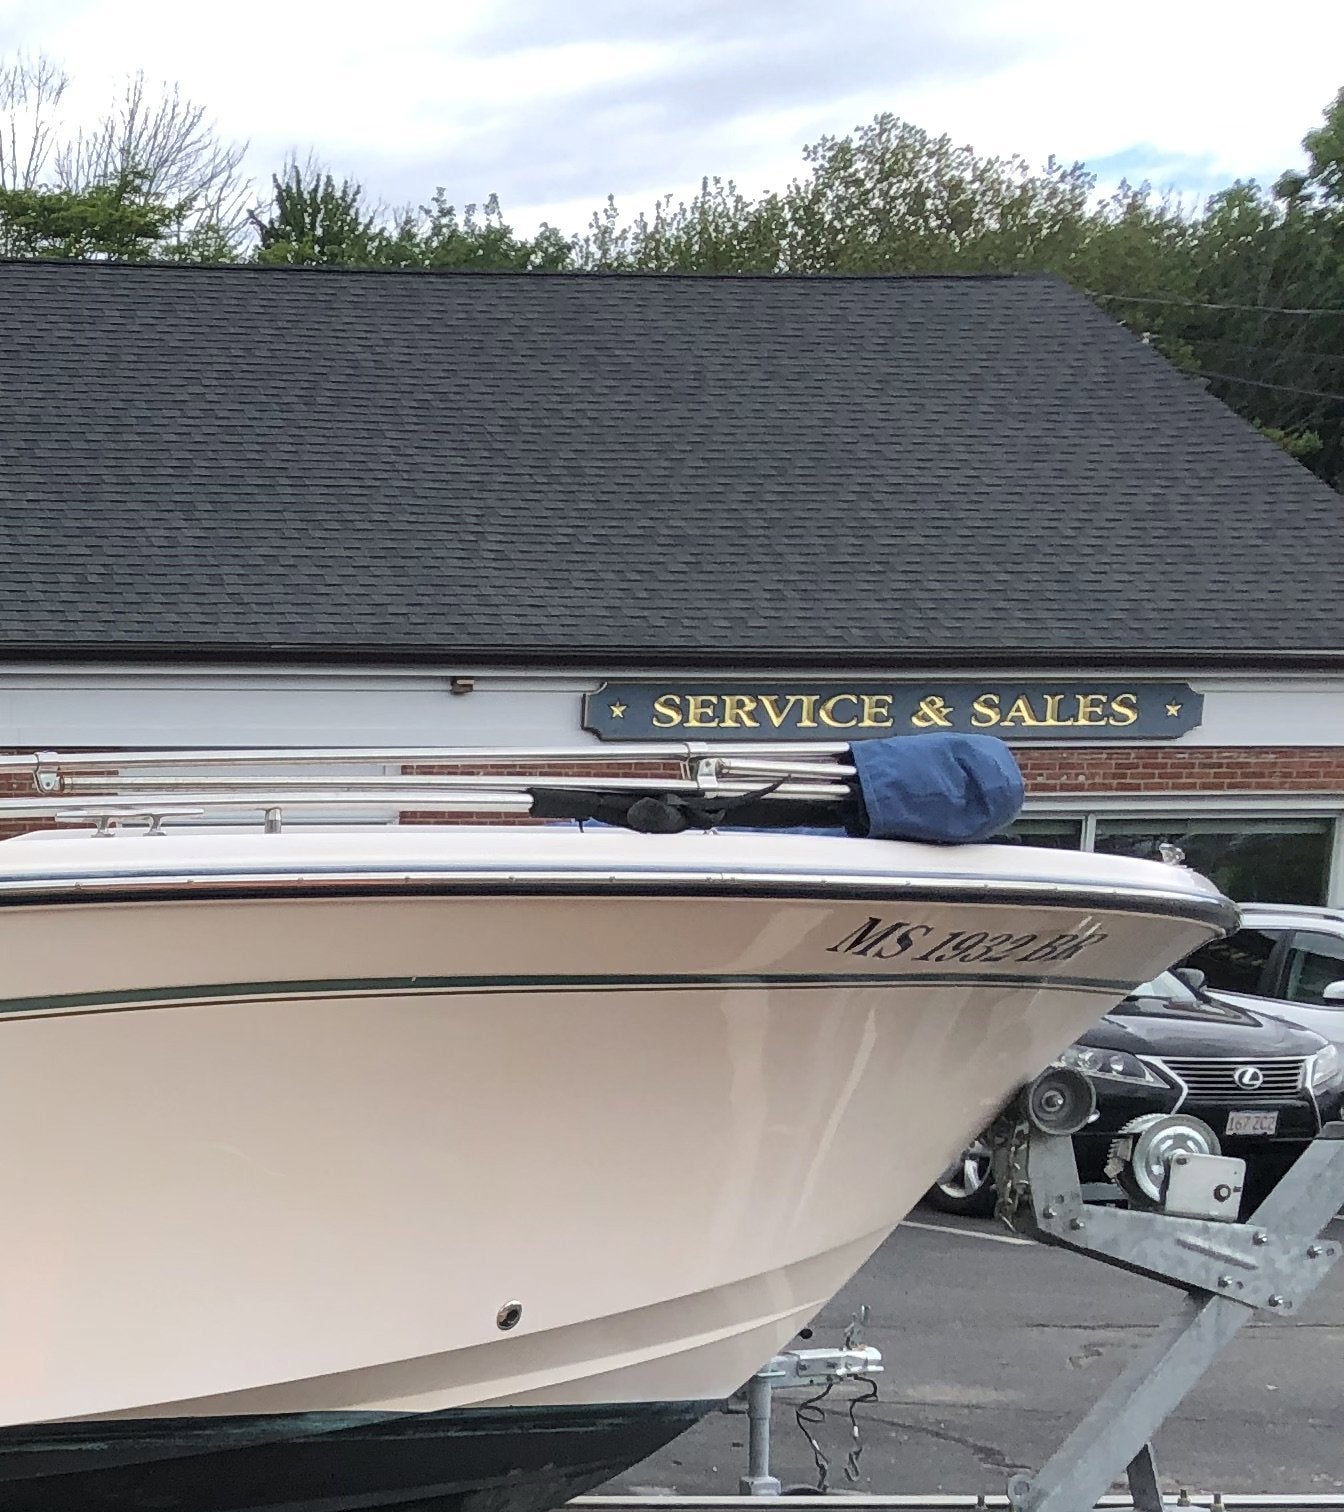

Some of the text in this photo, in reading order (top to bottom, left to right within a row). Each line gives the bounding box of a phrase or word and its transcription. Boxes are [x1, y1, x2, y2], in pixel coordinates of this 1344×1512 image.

[652, 693, 1138, 728] SERVICE & SALES
[825, 916, 934, 958] MS
[912, 931, 1038, 962] 1932
